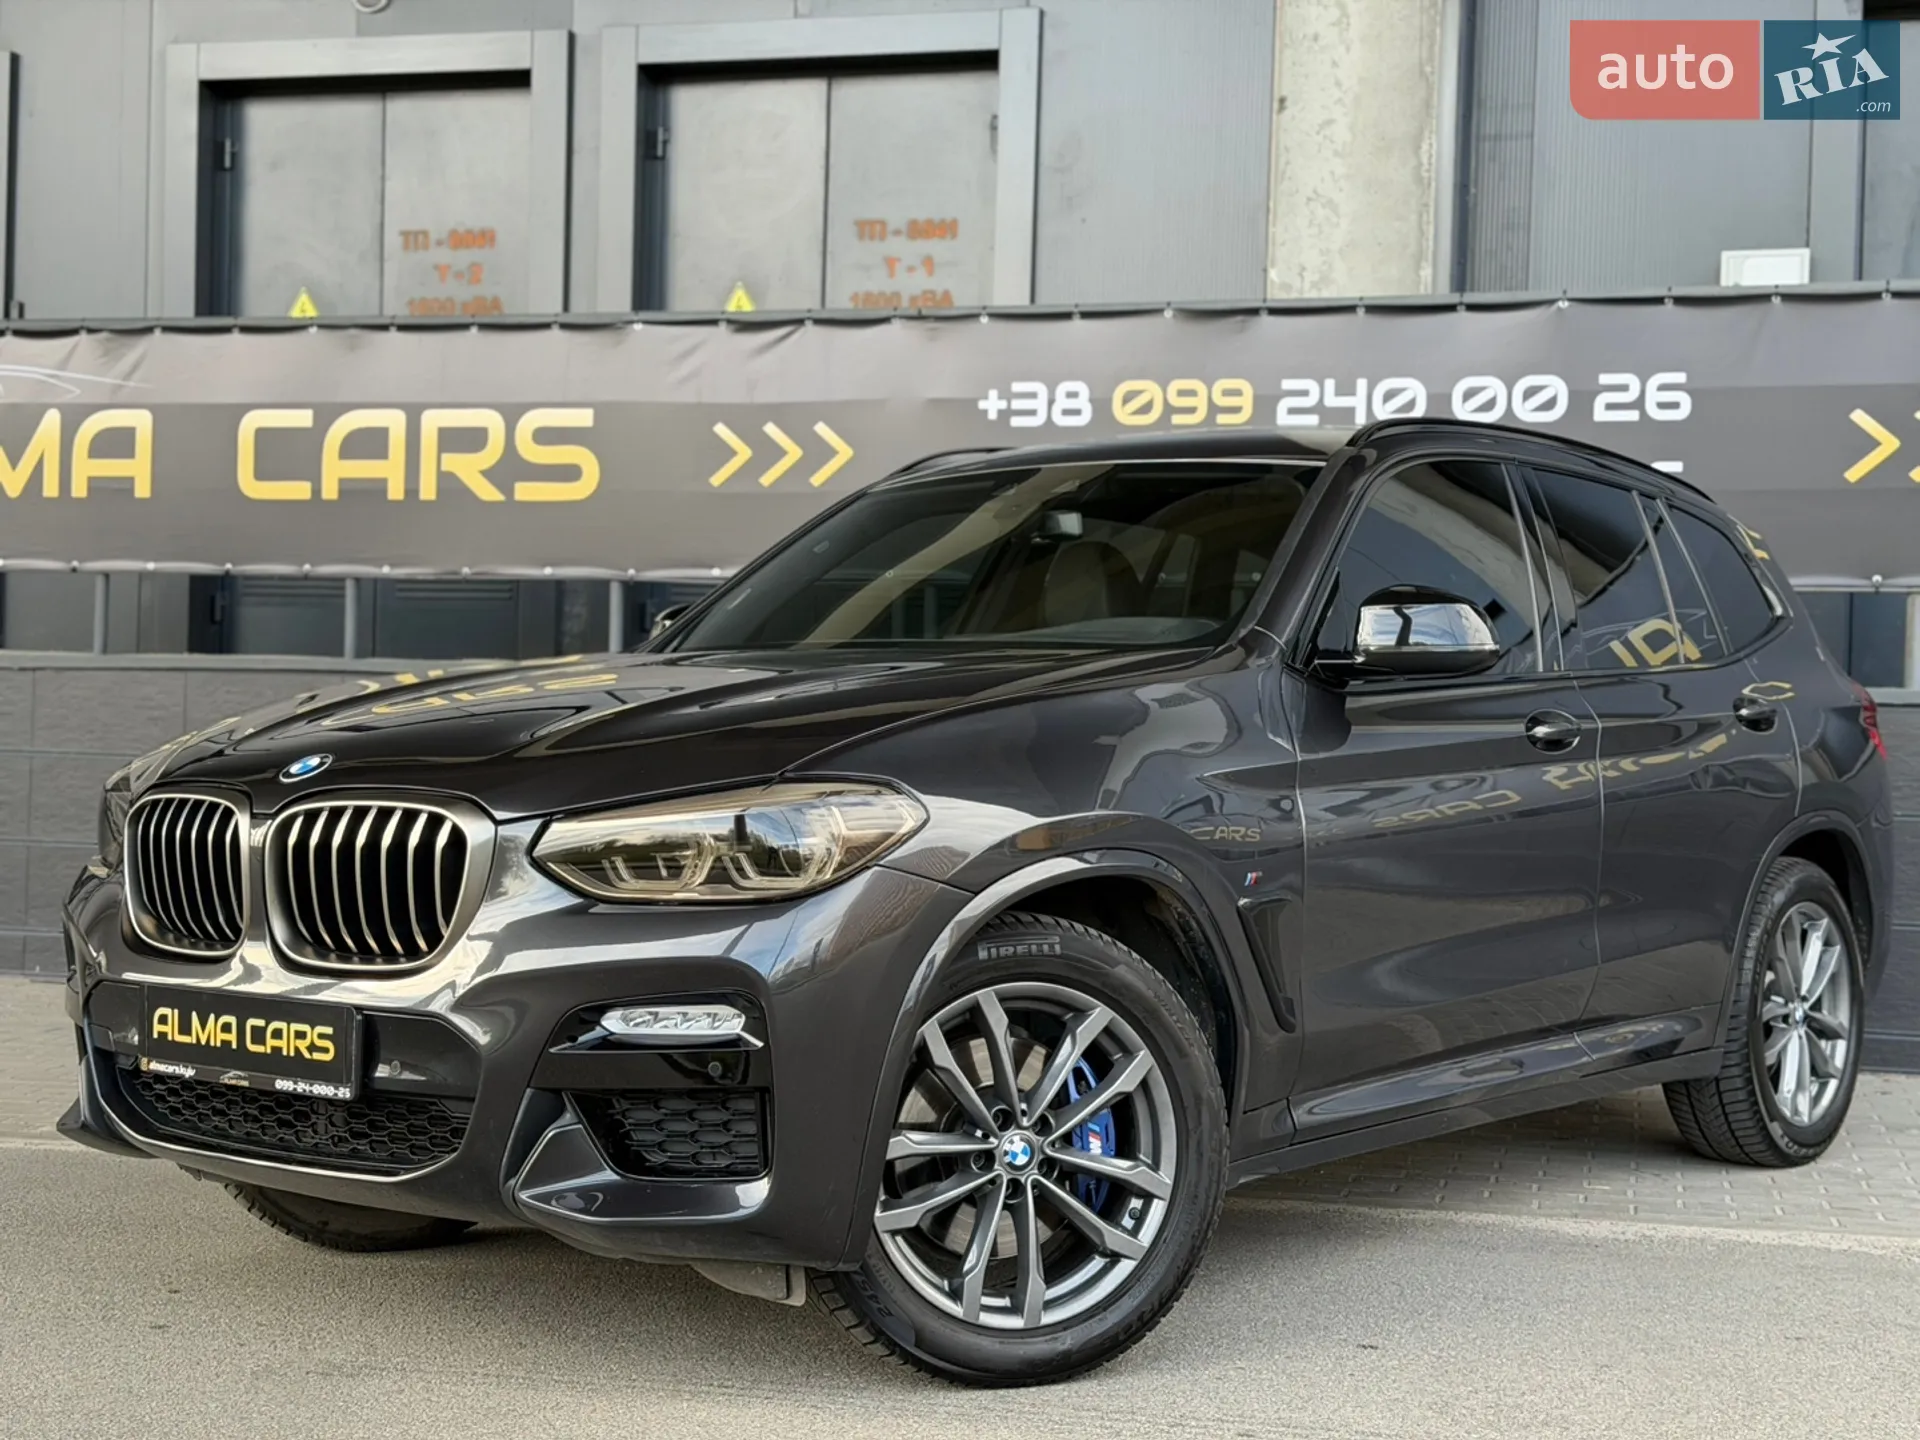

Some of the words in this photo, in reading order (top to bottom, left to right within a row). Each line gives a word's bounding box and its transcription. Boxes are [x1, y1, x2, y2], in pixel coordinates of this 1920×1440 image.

[978, 380, 1092, 427] +38
[1112, 378, 1254, 426] 099
[1276, 377, 1427, 425] 240
[1451, 375, 1568, 423] 00
[1593, 372, 1692, 422] 26
[237, 408, 600, 501] CARS
[977, 935, 1062, 961] PIRELLI
[153, 1006, 237, 1049] ALMA
[245, 1017, 335, 1062] CARS
